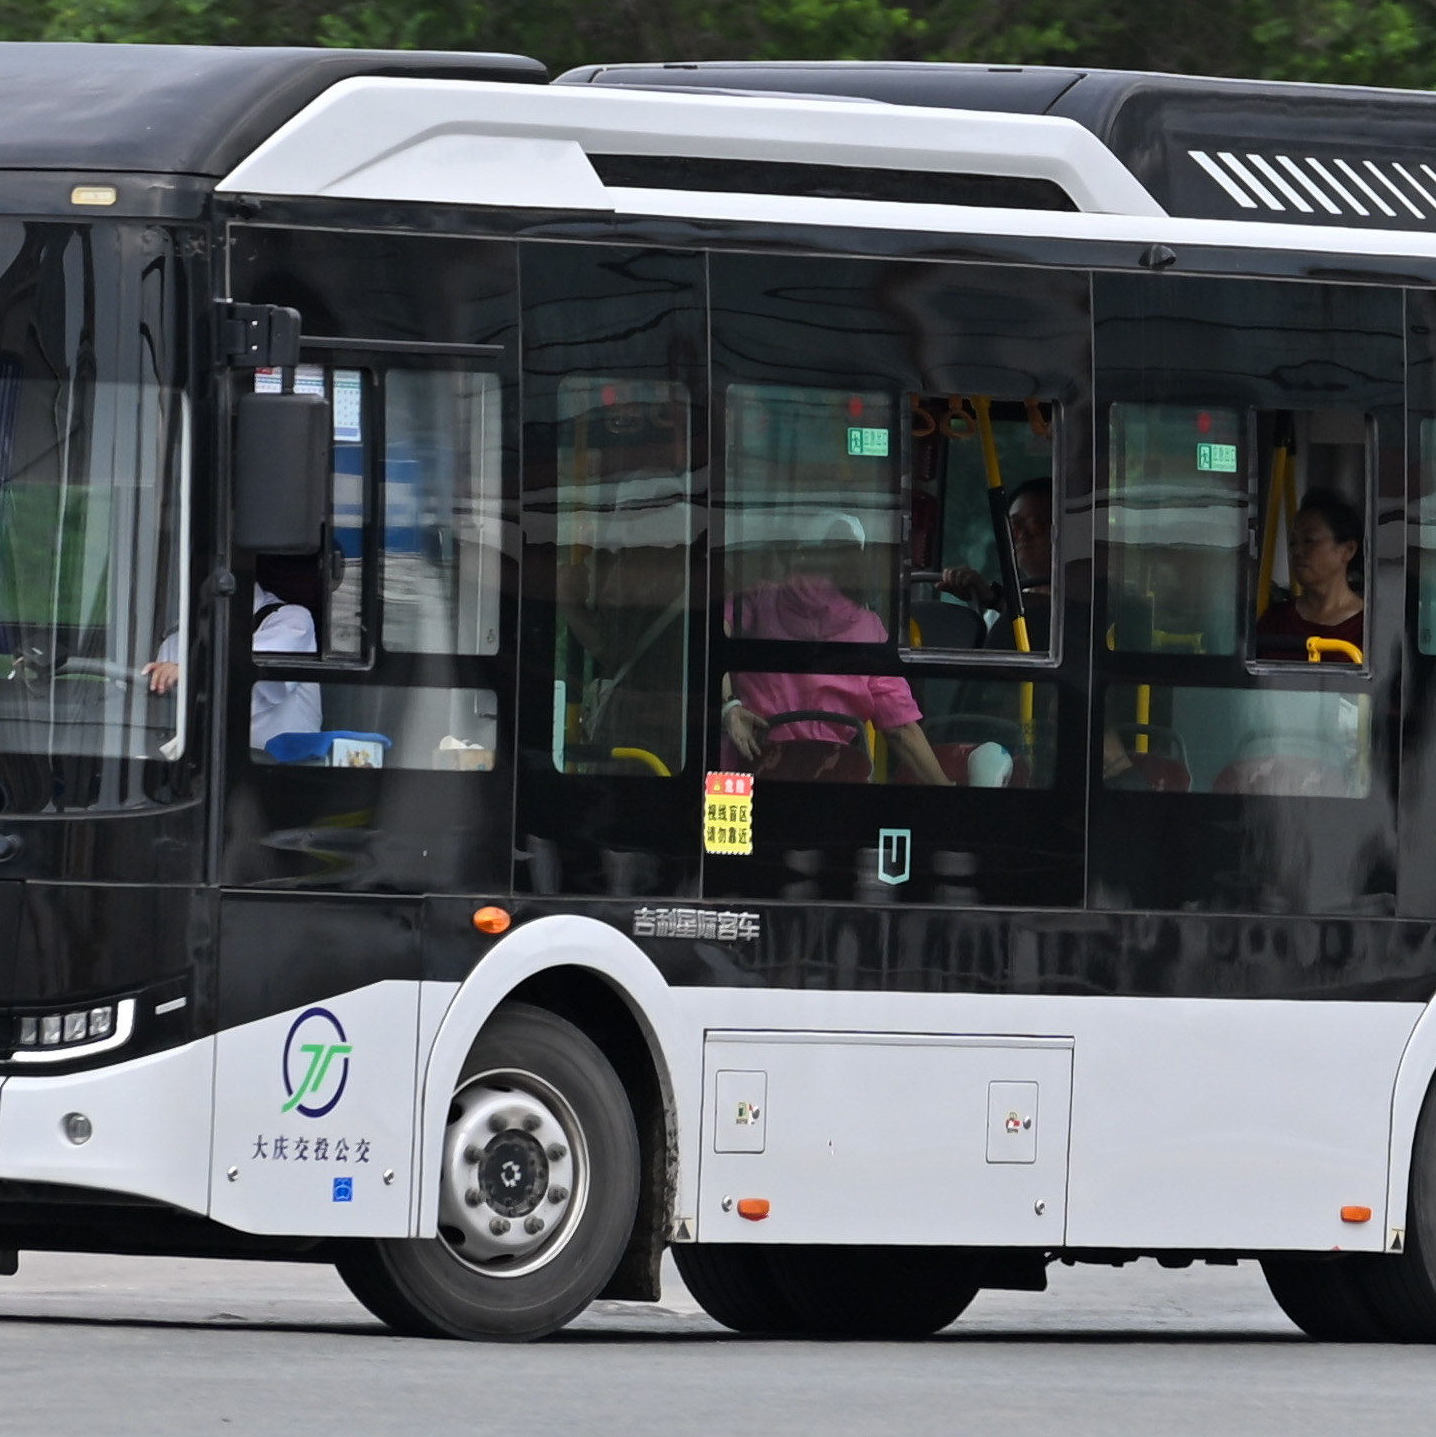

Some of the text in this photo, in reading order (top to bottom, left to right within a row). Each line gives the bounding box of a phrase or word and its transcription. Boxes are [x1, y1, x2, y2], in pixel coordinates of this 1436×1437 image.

[708, 804, 748, 823] 视线盲区
[707, 825, 748, 845] 请勿靠近
[633, 907, 761, 942] 吉利星际客车
[251, 1134, 371, 1164] 大庆交投公交
